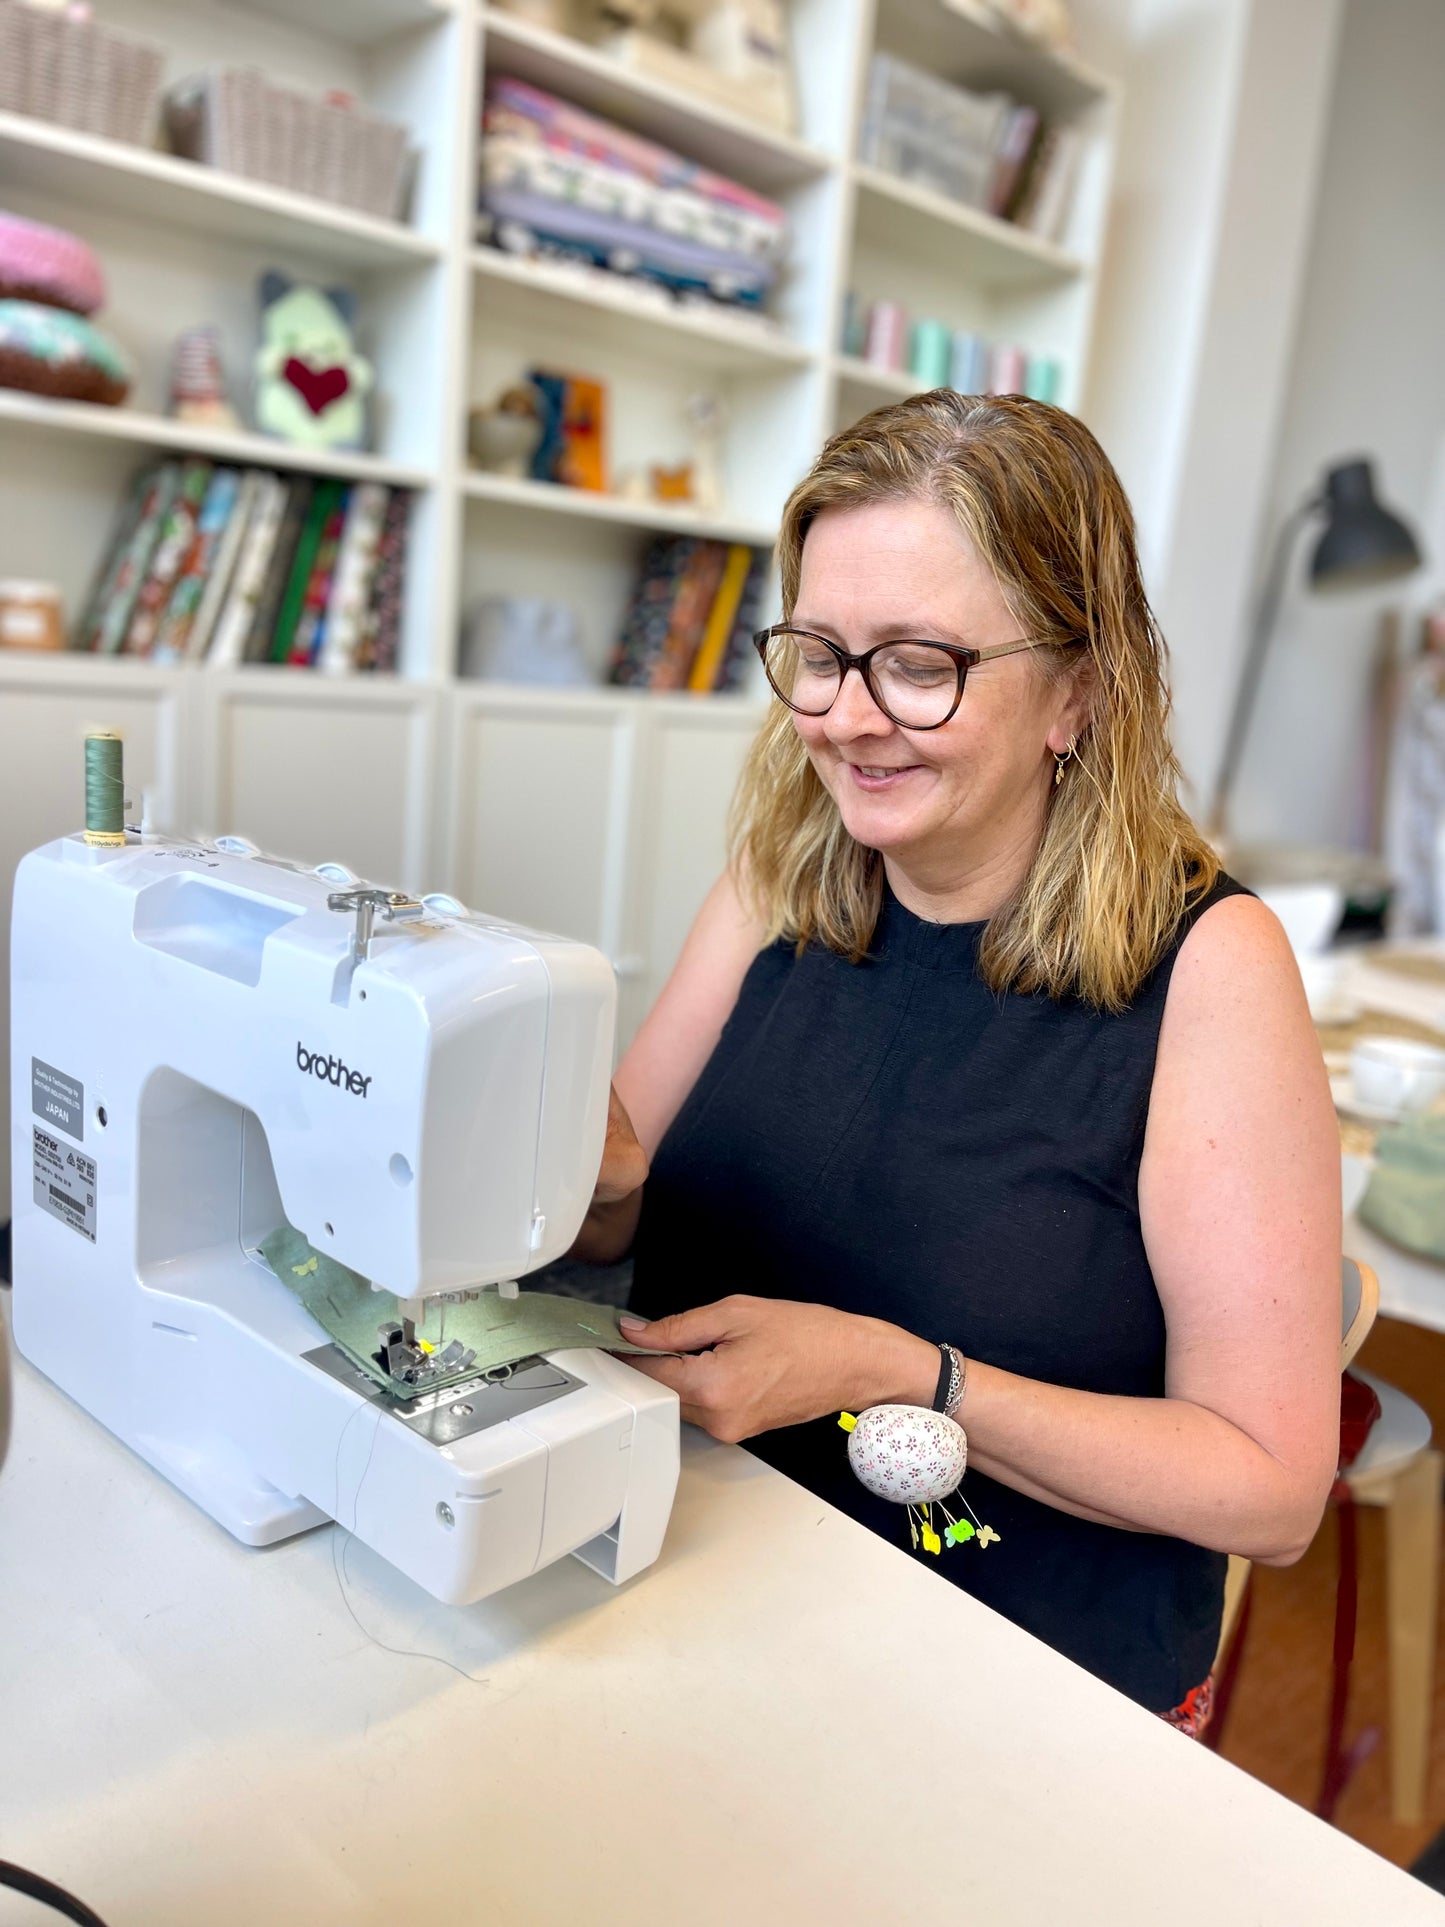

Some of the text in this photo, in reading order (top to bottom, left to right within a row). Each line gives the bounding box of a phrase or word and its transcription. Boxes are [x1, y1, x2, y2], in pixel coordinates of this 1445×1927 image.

[297, 1041, 372, 1098] brother
[34, 1079, 50, 1092] BROTHER
[36, 1068, 48, 1081] Quality
[53, 1077, 73, 1095] Technology
[46, 1101, 69, 1123] JAPAN
[34, 1129, 58, 1151] brother
